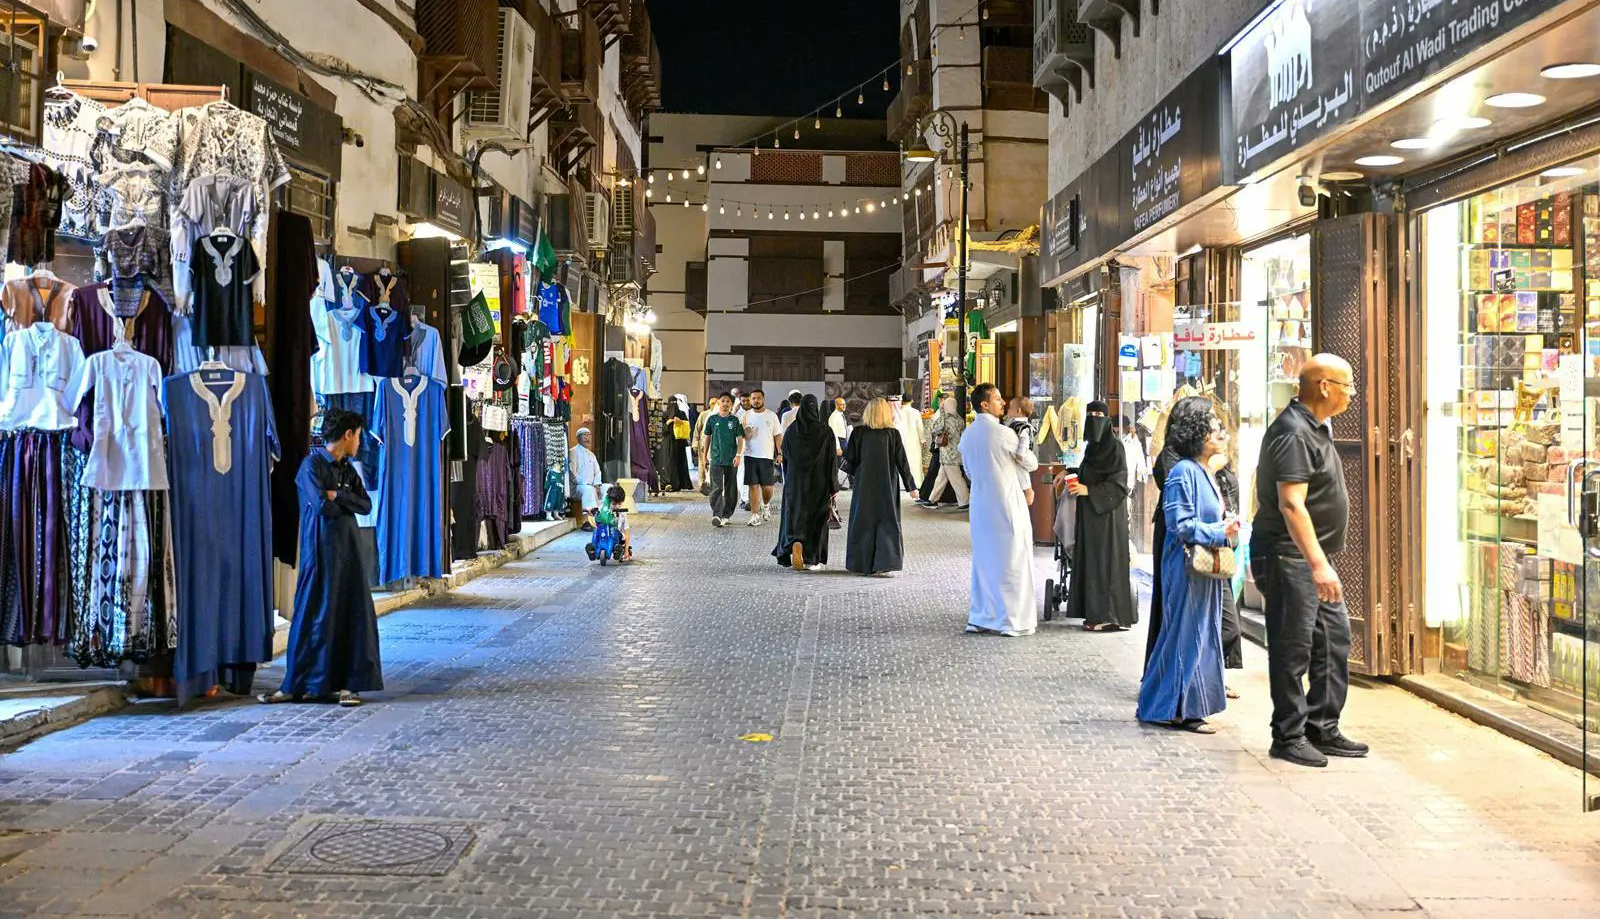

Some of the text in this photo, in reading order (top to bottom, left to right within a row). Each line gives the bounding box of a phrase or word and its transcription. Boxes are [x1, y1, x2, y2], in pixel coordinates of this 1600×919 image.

[1365, 1, 1499, 94] Qutouf Al Wadi Trading
[1132, 105, 1181, 182] عطارة يافع
[1237, 110, 1288, 169] للعطارة
[1132, 180, 1151, 211] العطارة
[1149, 190, 1180, 223] PERFUMERY
[1208, 327, 1255, 345] عطارة
